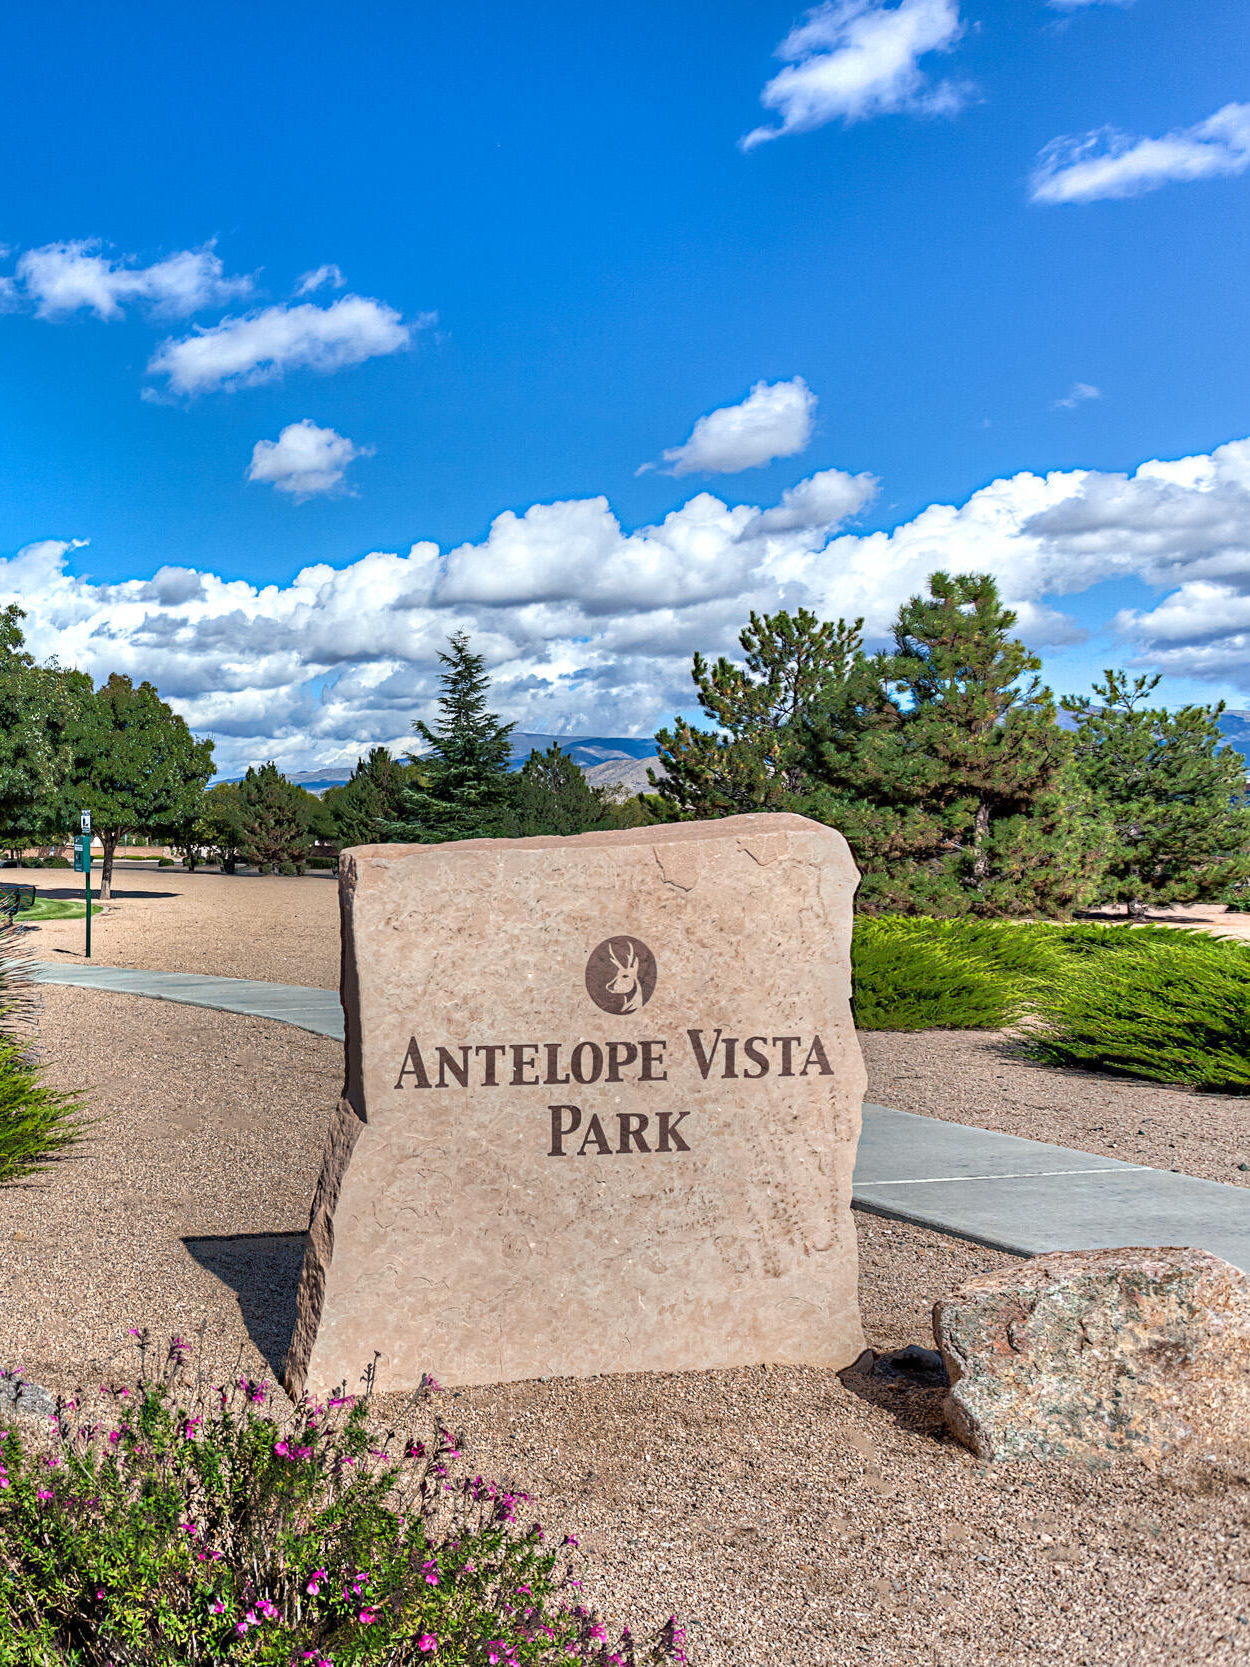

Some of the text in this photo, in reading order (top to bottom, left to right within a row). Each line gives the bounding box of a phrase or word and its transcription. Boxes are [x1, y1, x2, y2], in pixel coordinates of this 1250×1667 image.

[394, 1028, 835, 1089] ANTELOPE VISTA
[547, 1105, 691, 1157] PARK
